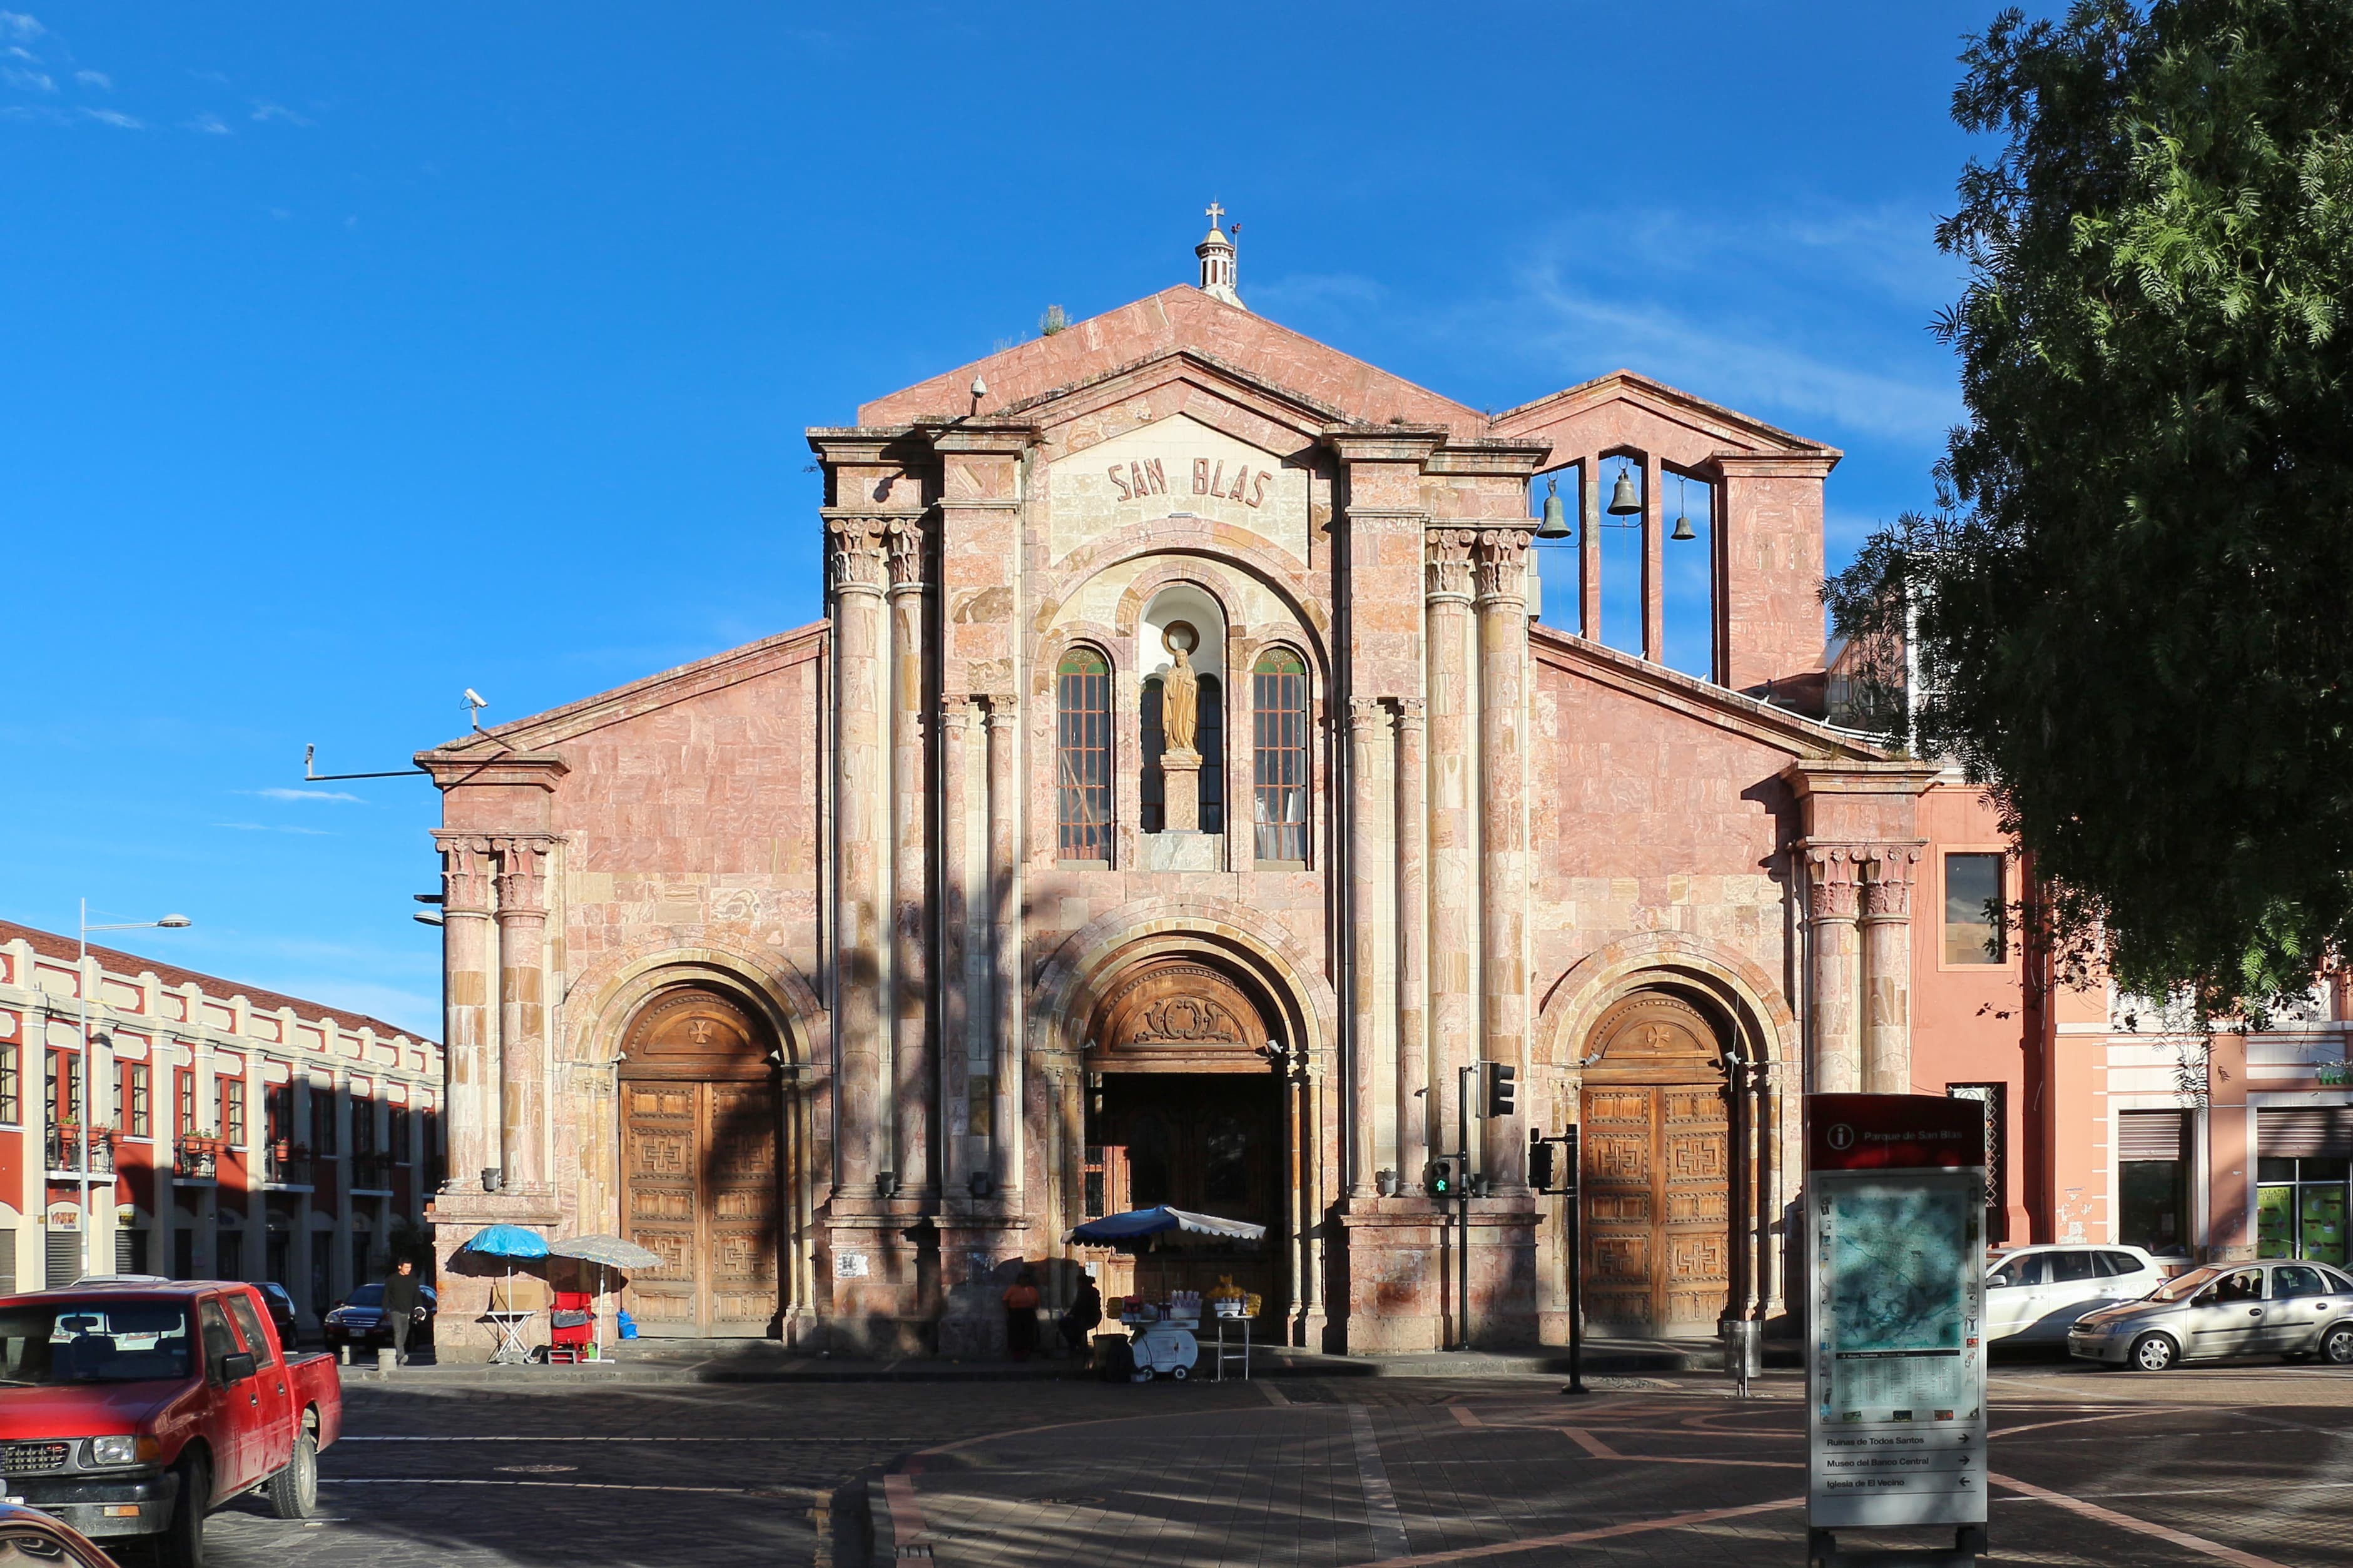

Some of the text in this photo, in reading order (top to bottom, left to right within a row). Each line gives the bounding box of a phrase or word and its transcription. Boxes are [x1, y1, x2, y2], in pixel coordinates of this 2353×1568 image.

[1108, 457, 1273, 508] SAN BLAS
[1864, 1130, 1962, 1141] Parque de San Blas
[1827, 1438, 1855, 1447] Ruinas
[1869, 1437, 1894, 1445] Todos
[1896, 1436, 1924, 1444] Santos
[1827, 1457, 1929, 1467] Museo del Banco Central
[1827, 1479, 1853, 1489] Iglesia
